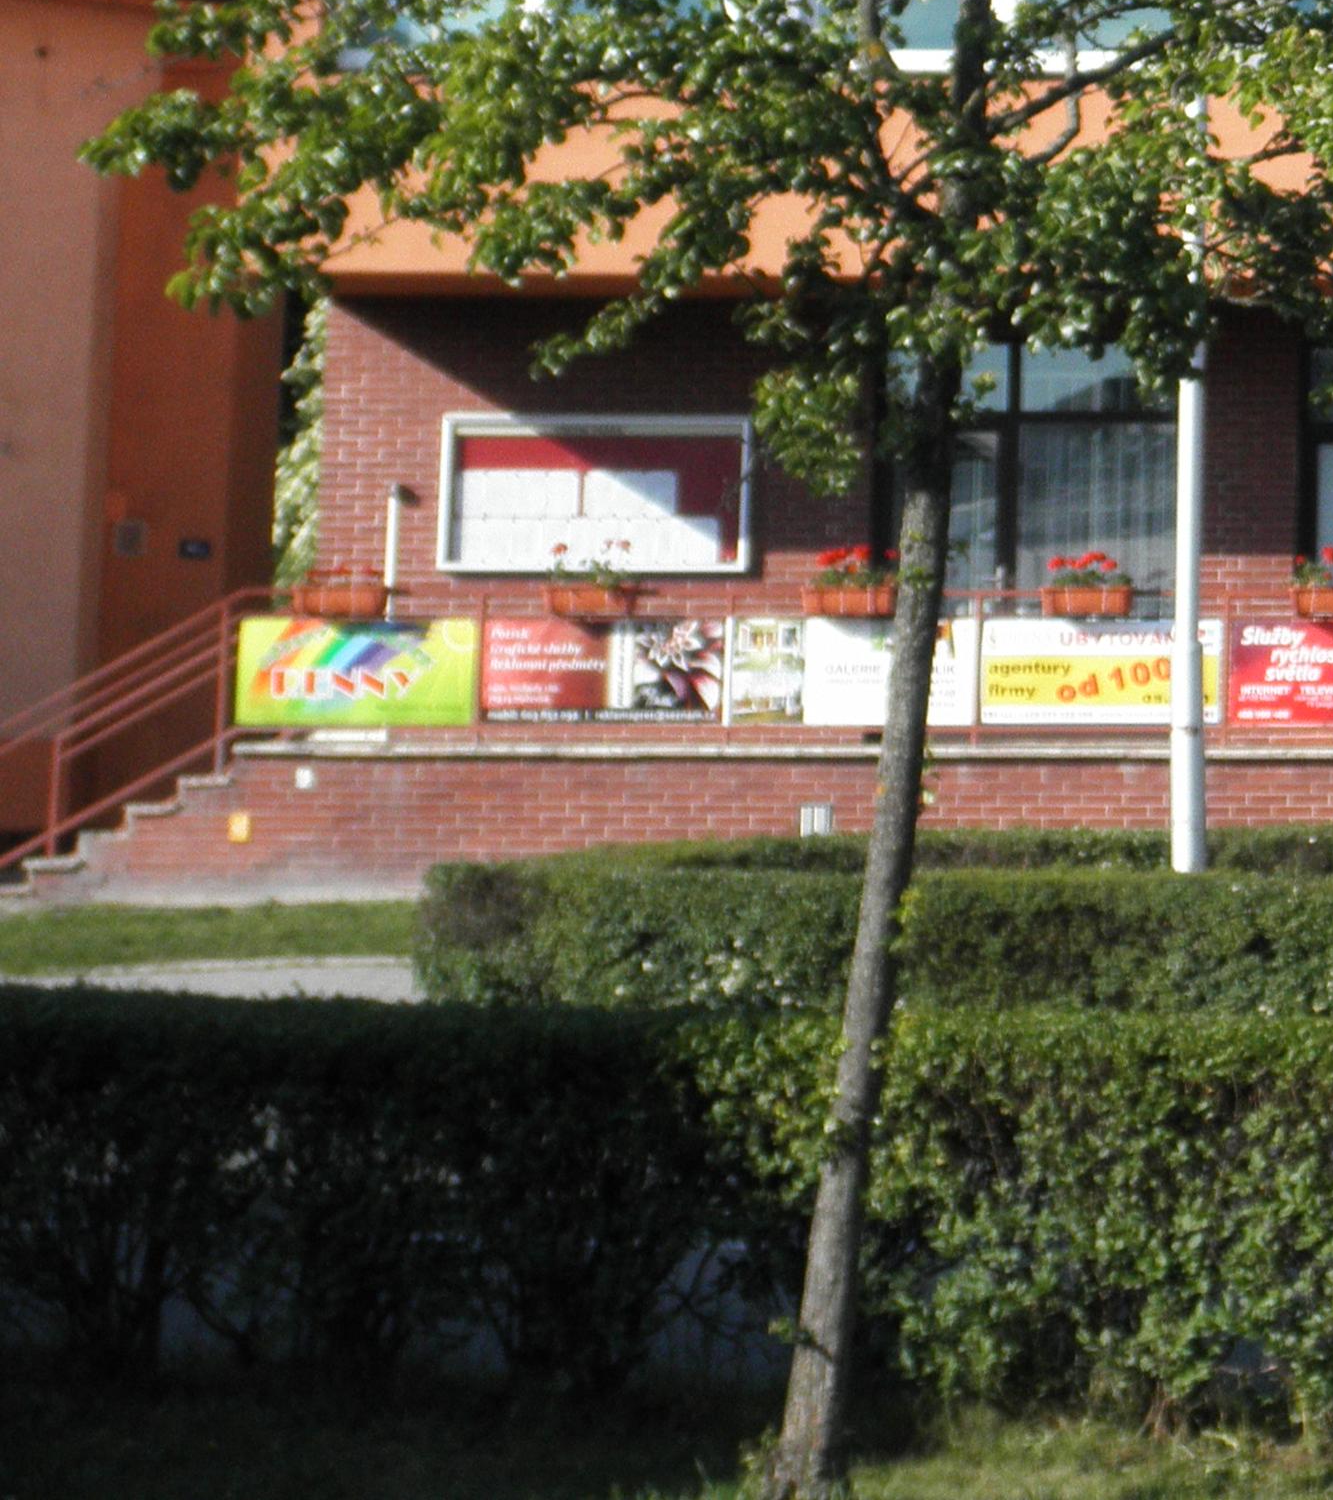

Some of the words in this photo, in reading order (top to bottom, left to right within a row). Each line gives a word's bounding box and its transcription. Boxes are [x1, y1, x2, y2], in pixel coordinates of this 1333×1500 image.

[1240, 626, 1305, 648] Služby
[988, 661, 1072, 678] agentury
[1264, 663, 1322, 682] světla
[988, 683, 1038, 700] firmy
[1056, 672, 1099, 704] od
